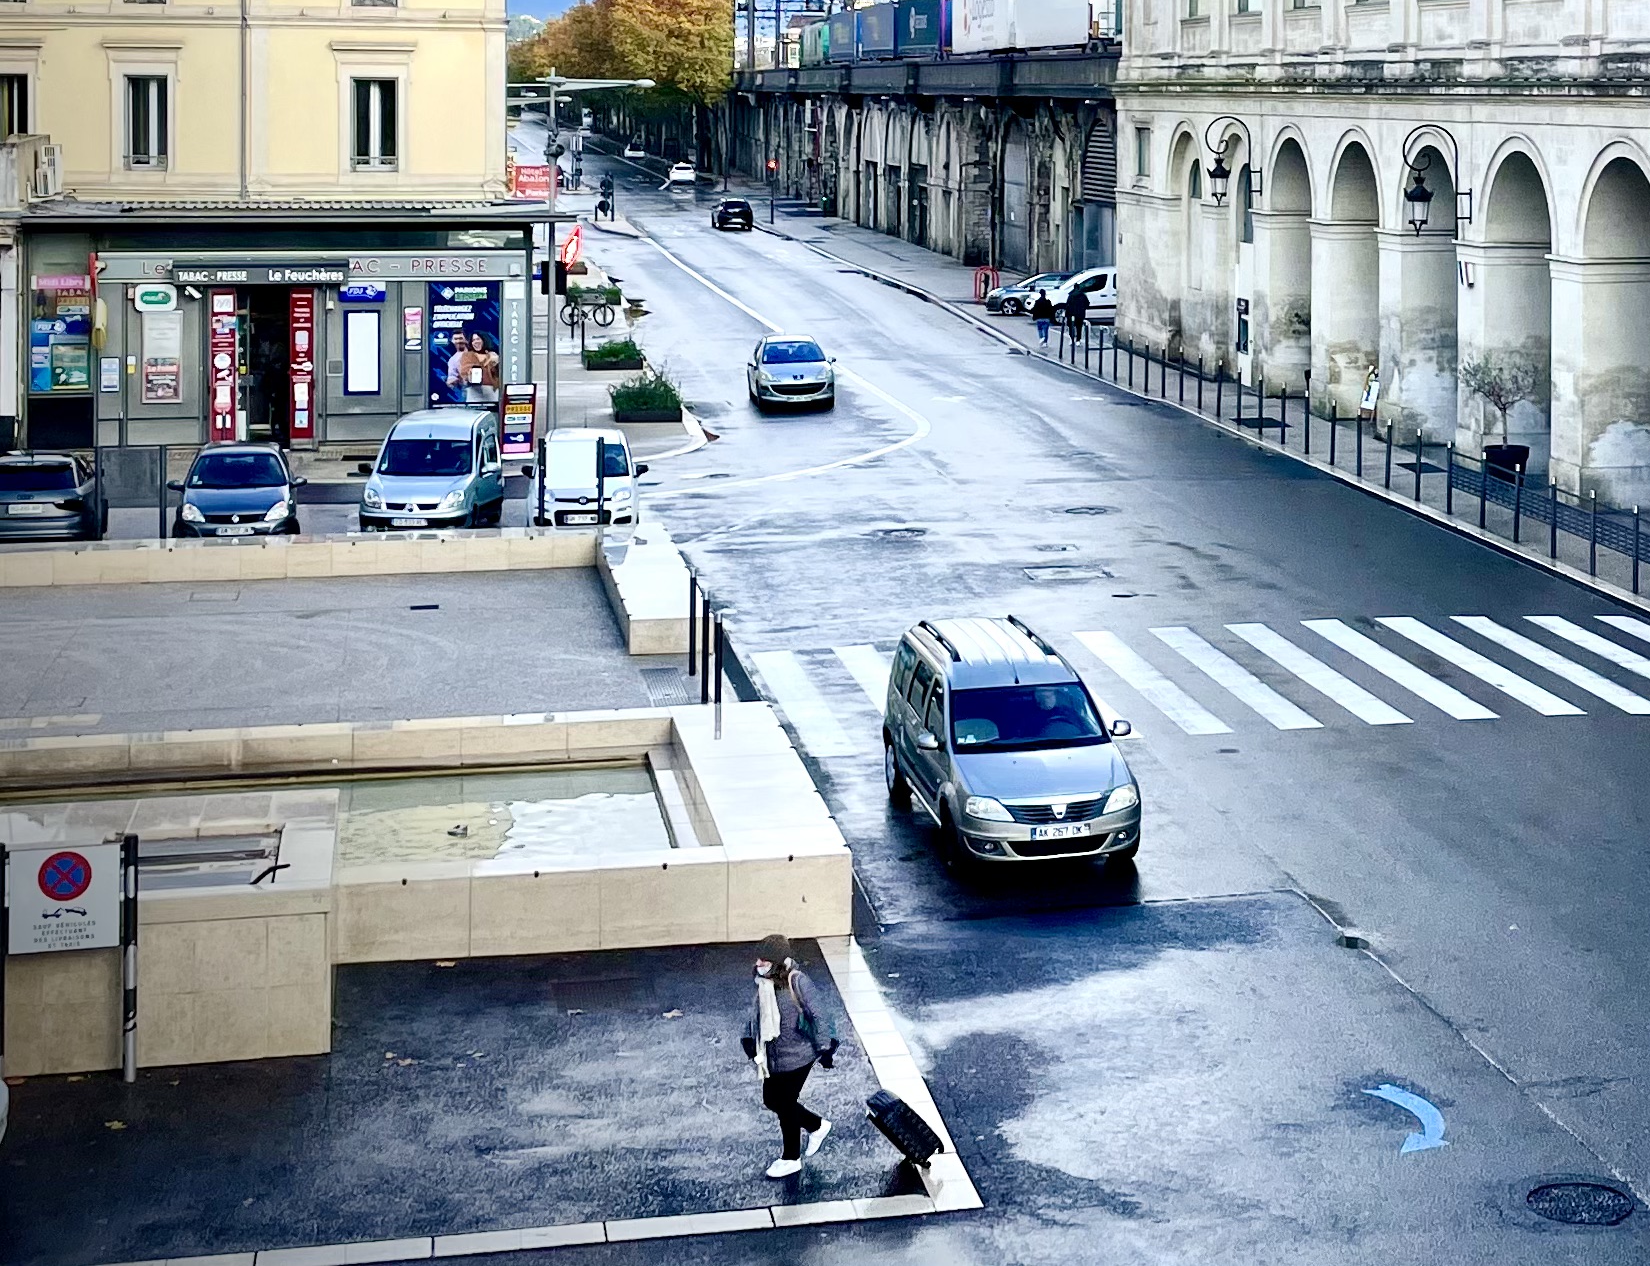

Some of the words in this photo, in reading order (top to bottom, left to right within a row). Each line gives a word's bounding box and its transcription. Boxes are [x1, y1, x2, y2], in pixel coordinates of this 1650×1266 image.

[518, 174, 549, 182] Abalon
[411, 259, 488, 274] PRESSE
[178, 271, 209, 282] TABAC
[217, 271, 248, 282] PRESSE
[268, 270, 281, 281] Le
[284, 268, 344, 282] Feuchères
